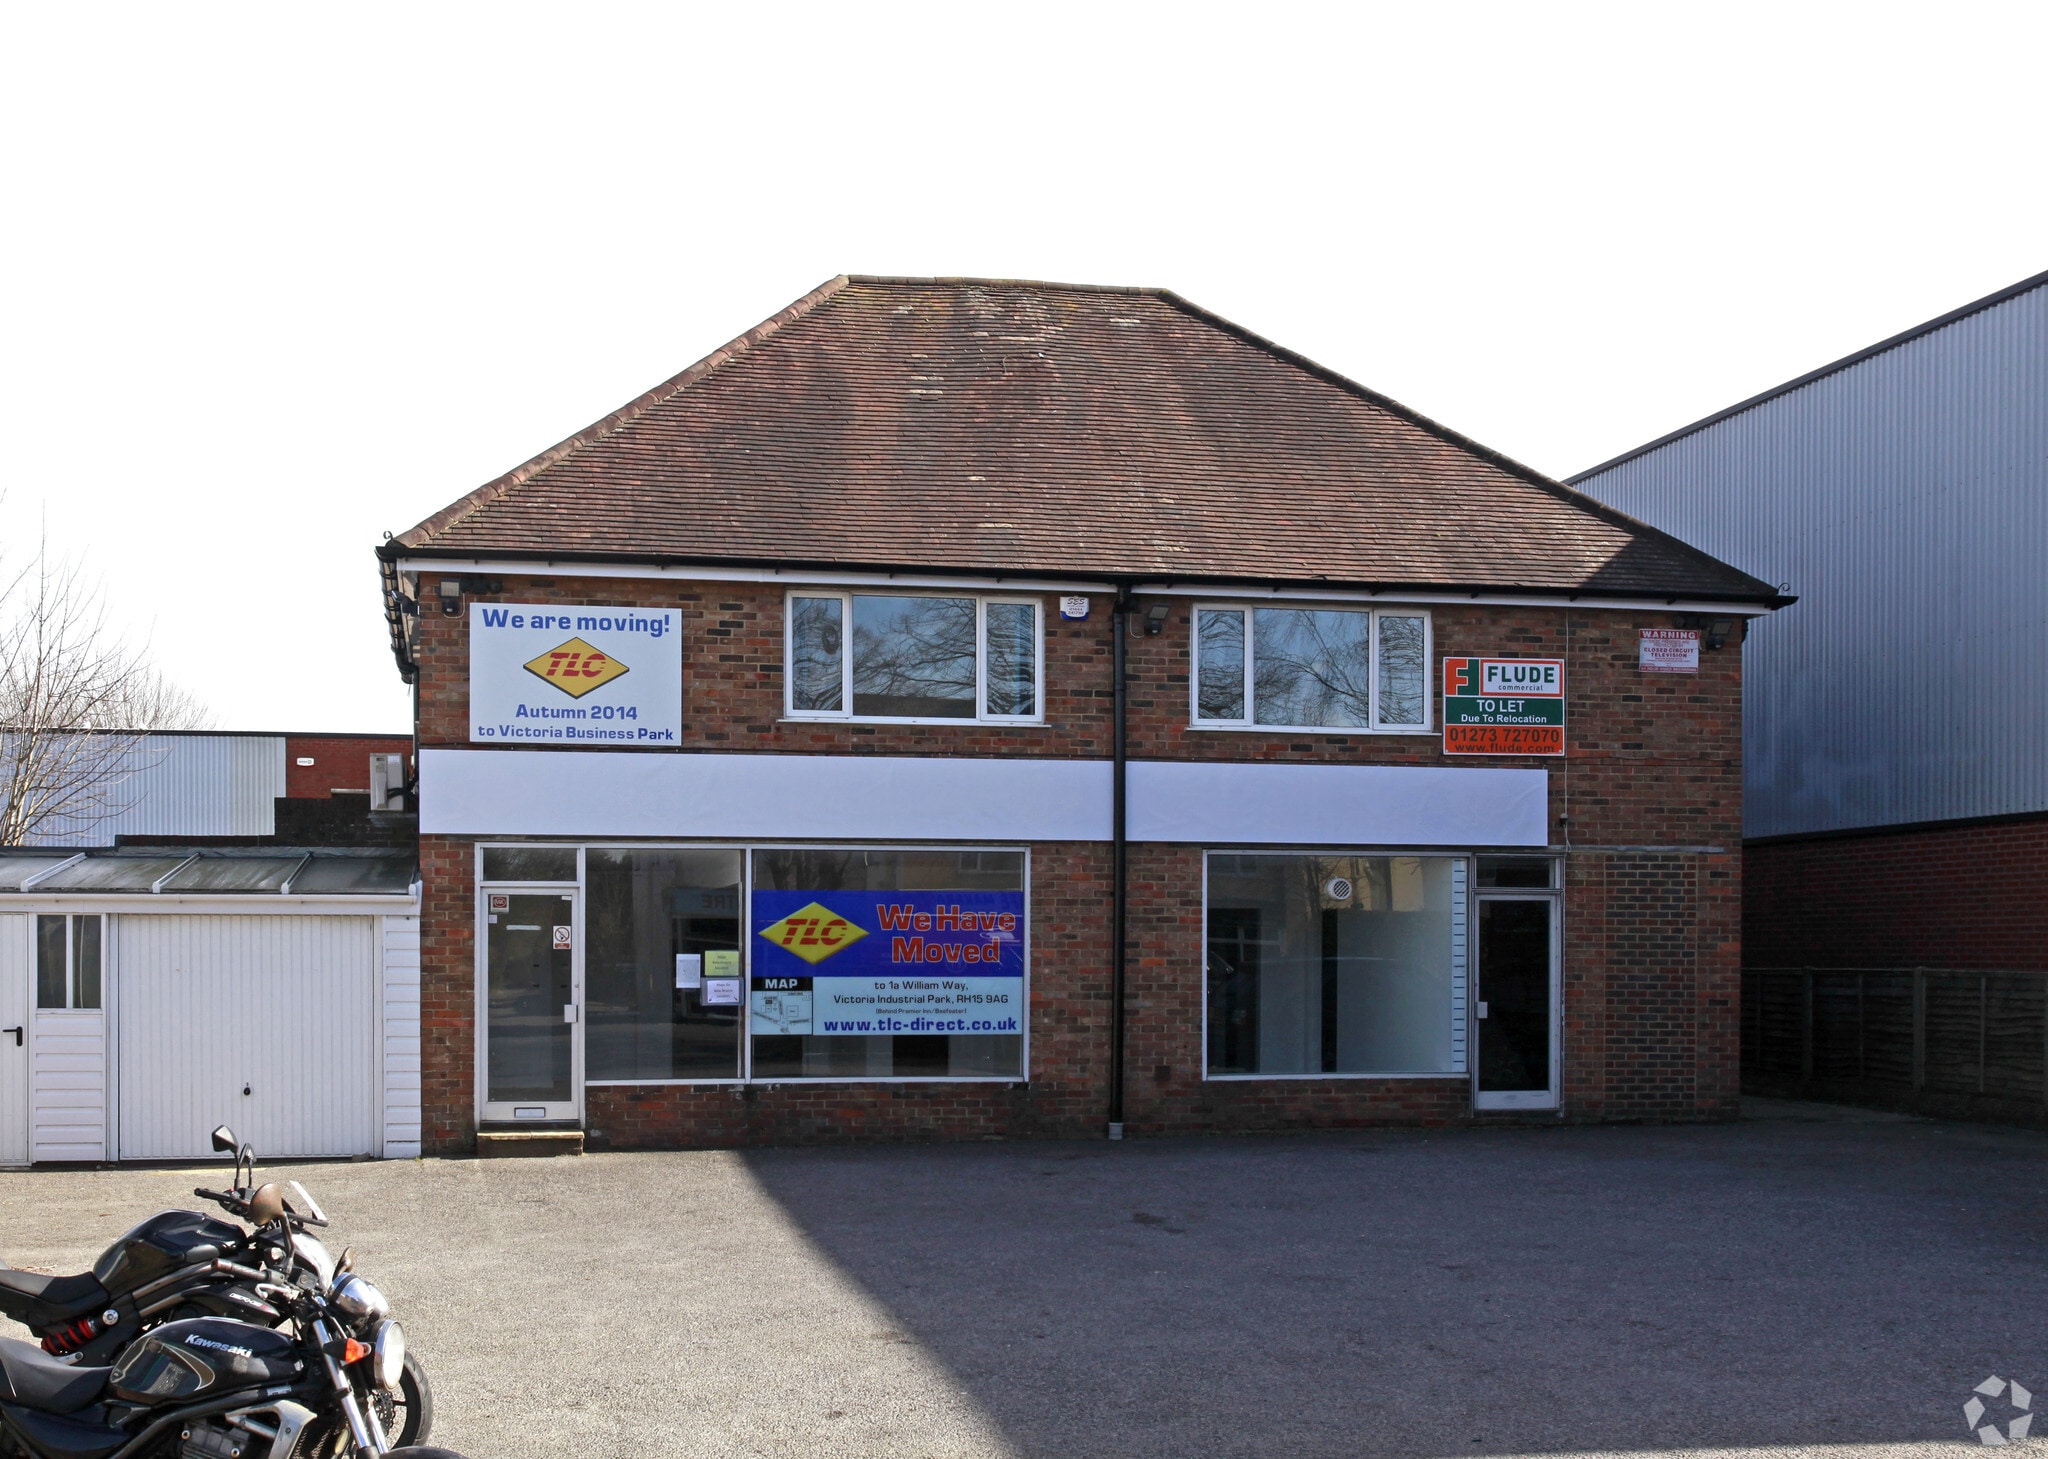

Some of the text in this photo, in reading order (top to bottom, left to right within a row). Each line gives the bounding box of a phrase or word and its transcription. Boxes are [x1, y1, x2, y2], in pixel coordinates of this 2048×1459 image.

[482, 608, 670, 638] We are moving!
[1642, 631, 1696, 639] WARNING
[546, 652, 606, 678] TLC
[1487, 666, 1555, 683] FLUDE
[515, 703, 638, 720] Autumn 2014
[1476, 700, 1525, 713] TO LET
[1461, 714, 1547, 723] Due To Relocation
[478, 724, 674, 741] to Victoria Business Park
[1449, 728, 1560, 743] 01273 727070
[1455, 743, 1555, 753] www.flude.com
[877, 904, 1016, 932] We Have
[781, 918, 848, 946] TLC
[892, 936, 1001, 963] Moved
[765, 978, 798, 989] MAP
[874, 980, 969, 992] to 1a William Way,
[833, 994, 1009, 1005] Victoria Industrial Park, RH15 9AG
[824, 1017, 1017, 1031] www.tlc-direct.co.uk
[185, 1334, 253, 1358] Kawasaki
